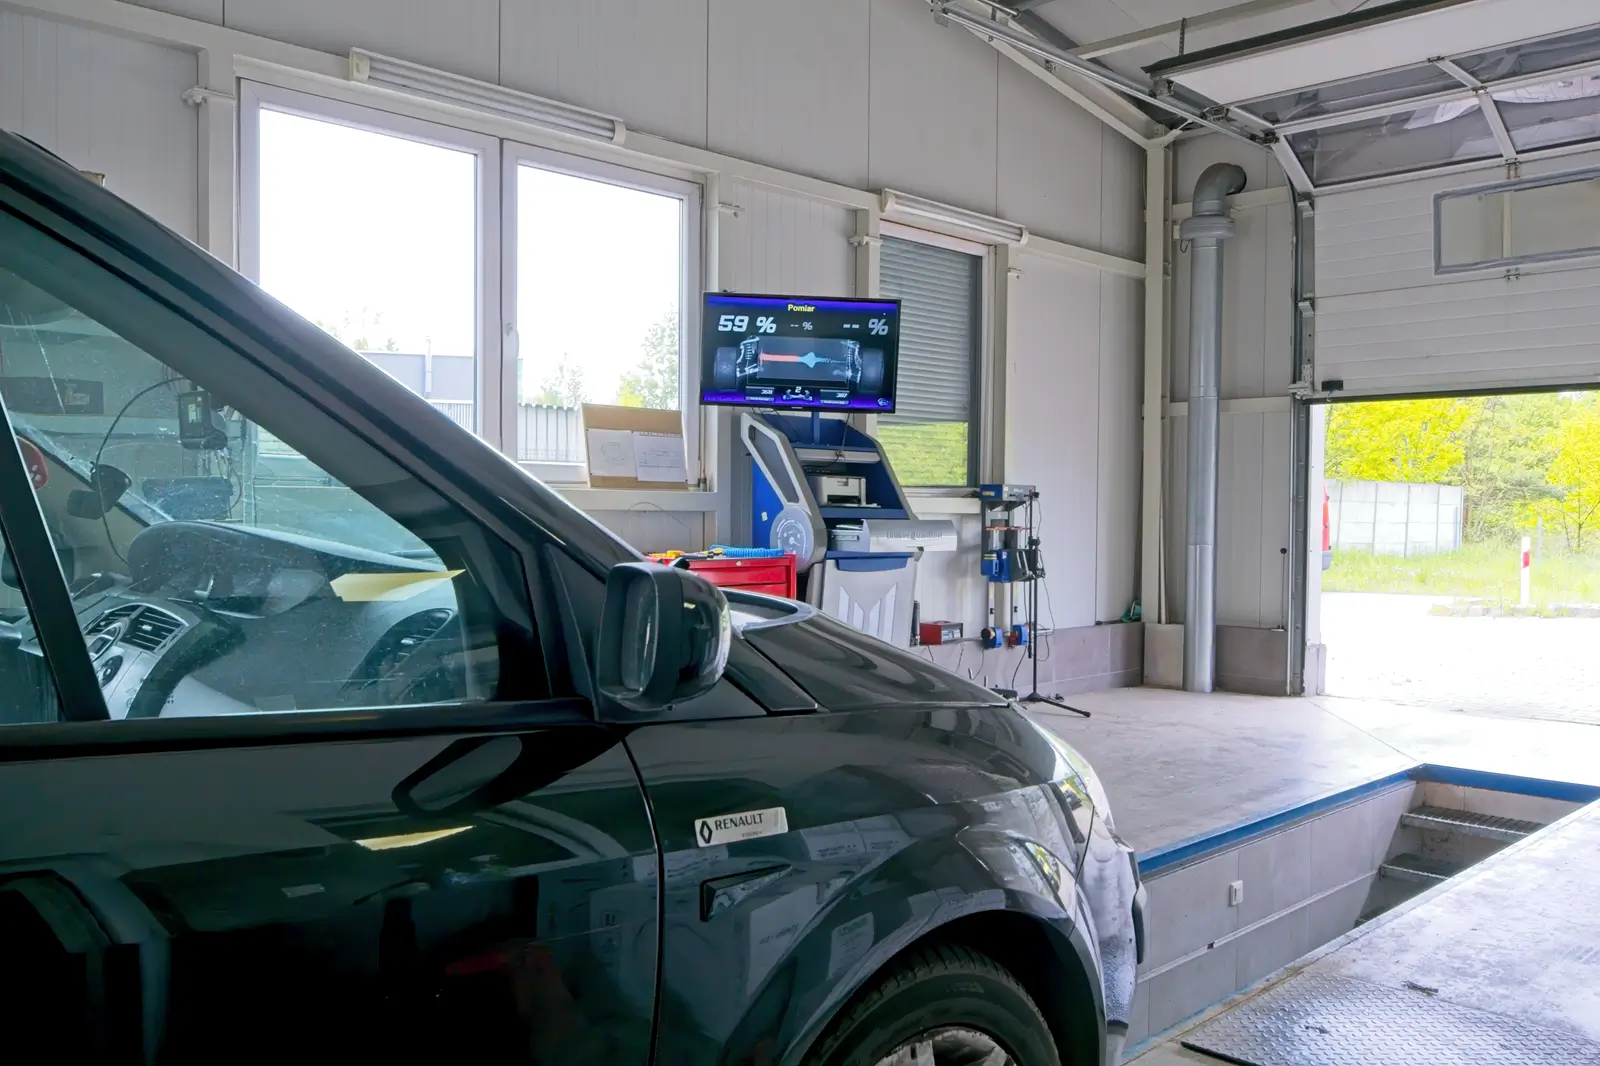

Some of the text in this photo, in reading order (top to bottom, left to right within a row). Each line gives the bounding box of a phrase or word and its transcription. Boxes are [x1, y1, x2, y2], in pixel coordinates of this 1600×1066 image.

[787, 303, 815, 313] Pomiar
[717, 314, 777, 334] 59 %
[802, 321, 813, 331] %
[868, 318, 889, 336] %
[714, 812, 764, 831] RENAULT
